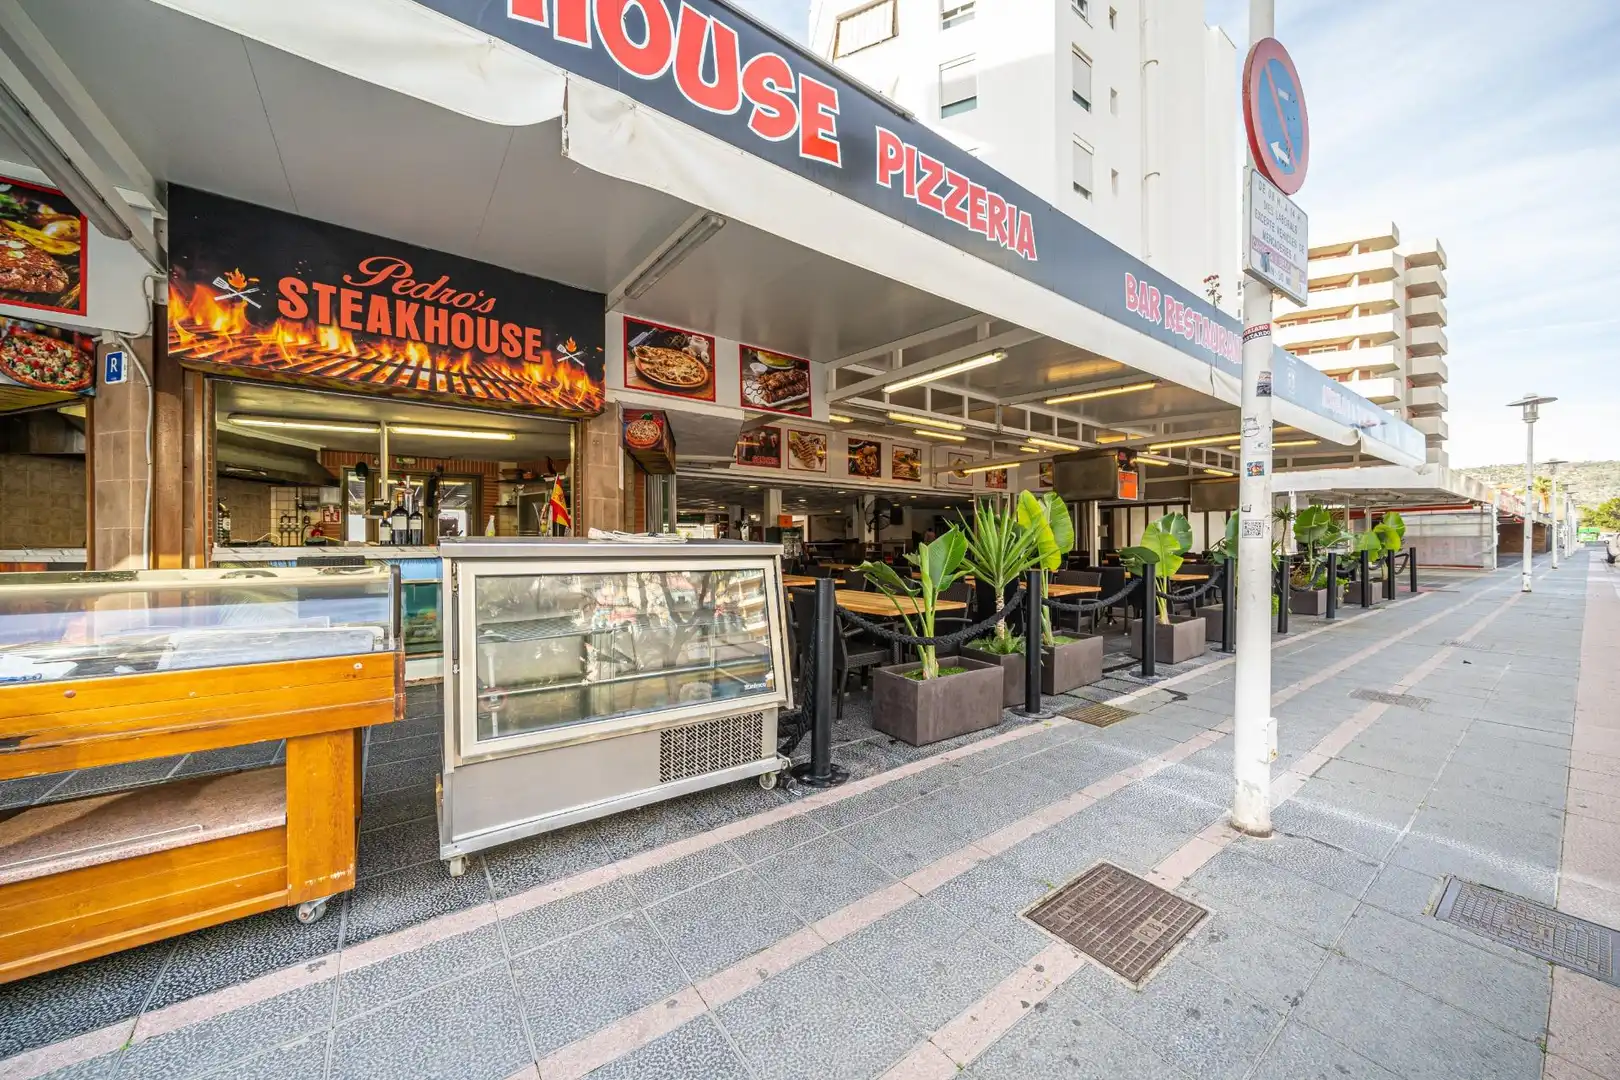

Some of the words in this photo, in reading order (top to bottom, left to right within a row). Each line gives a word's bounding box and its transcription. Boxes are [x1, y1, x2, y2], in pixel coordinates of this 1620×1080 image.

[875, 125, 1038, 261] PIZZERIA
[1254, 207, 1276, 233] EXCEPTE
[1263, 199, 1274, 216] DIES
[277, 276, 542, 363] STEAKHOUSE
[1125, 272, 1162, 325] BAR
[1164, 294, 1243, 365] RESTAURAN
[110, 357, 118, 373] R
